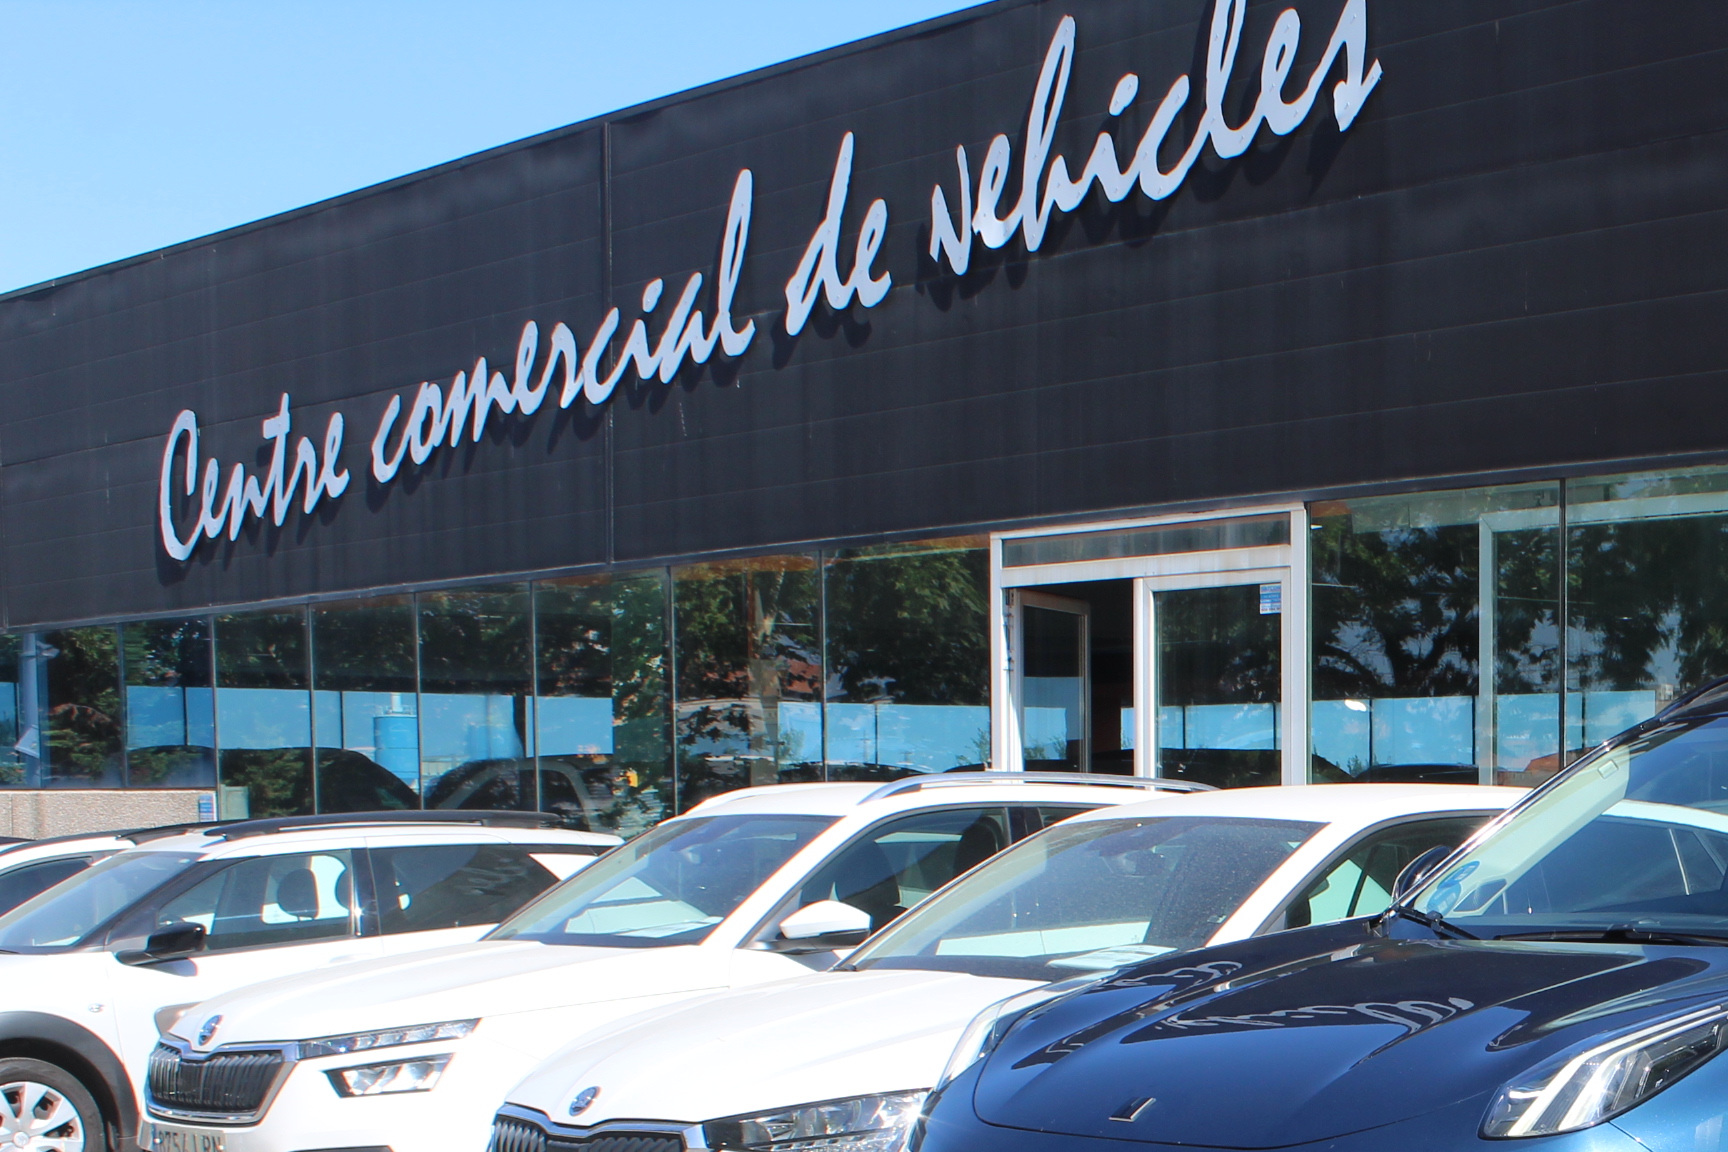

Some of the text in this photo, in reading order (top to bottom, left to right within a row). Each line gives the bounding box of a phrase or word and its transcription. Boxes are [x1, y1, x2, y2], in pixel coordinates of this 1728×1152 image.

[159, 0, 1383, 562] Centre comercial de vehicles
